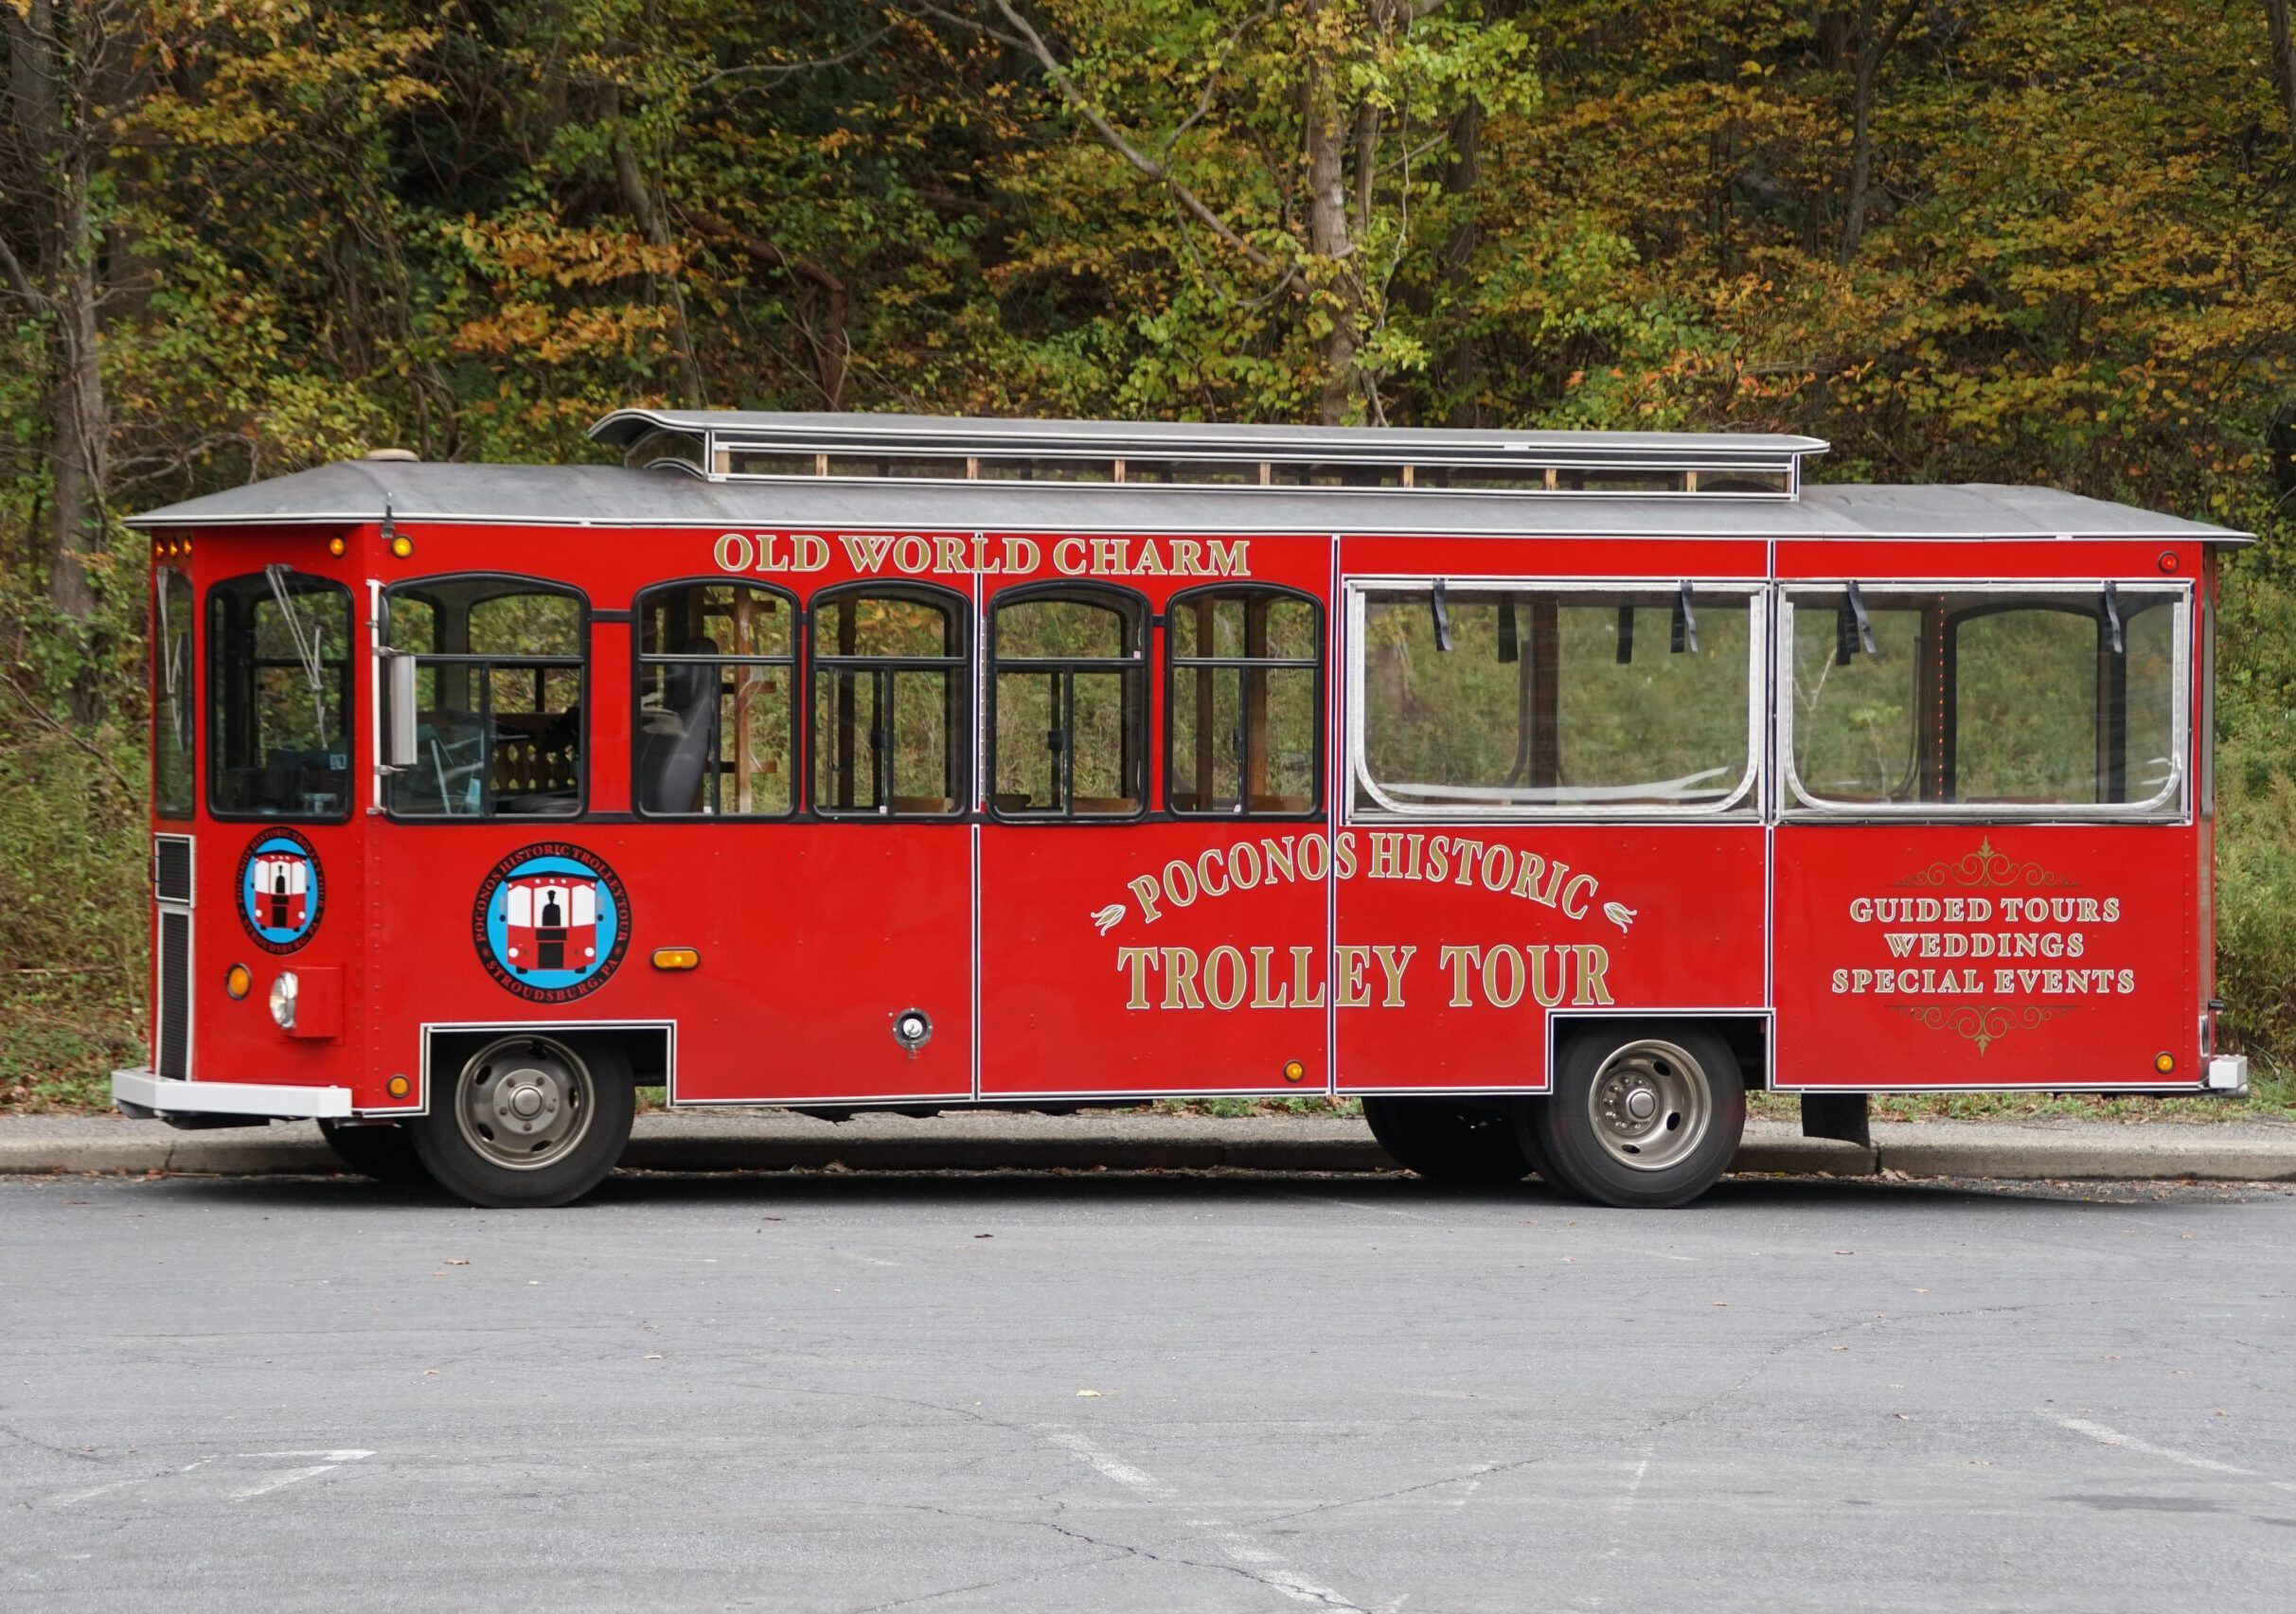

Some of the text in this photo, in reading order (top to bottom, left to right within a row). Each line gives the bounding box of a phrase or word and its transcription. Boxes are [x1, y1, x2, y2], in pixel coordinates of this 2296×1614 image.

[713, 533, 1252, 576] OLD WORLD CHARM
[474, 844, 629, 942] POCONOS HISTORIC TROLLEY TOUR
[1128, 832, 1599, 924] POCONOS HISTORIC
[1849, 897, 2121, 923] GUIDED TOURS
[1884, 932, 2085, 958] WEDDINGS
[603, 958, 619, 978] PA
[1117, 944, 1615, 1010] TROLLEY TOUR
[1832, 968, 2135, 994] SPECIAL EVENTS
